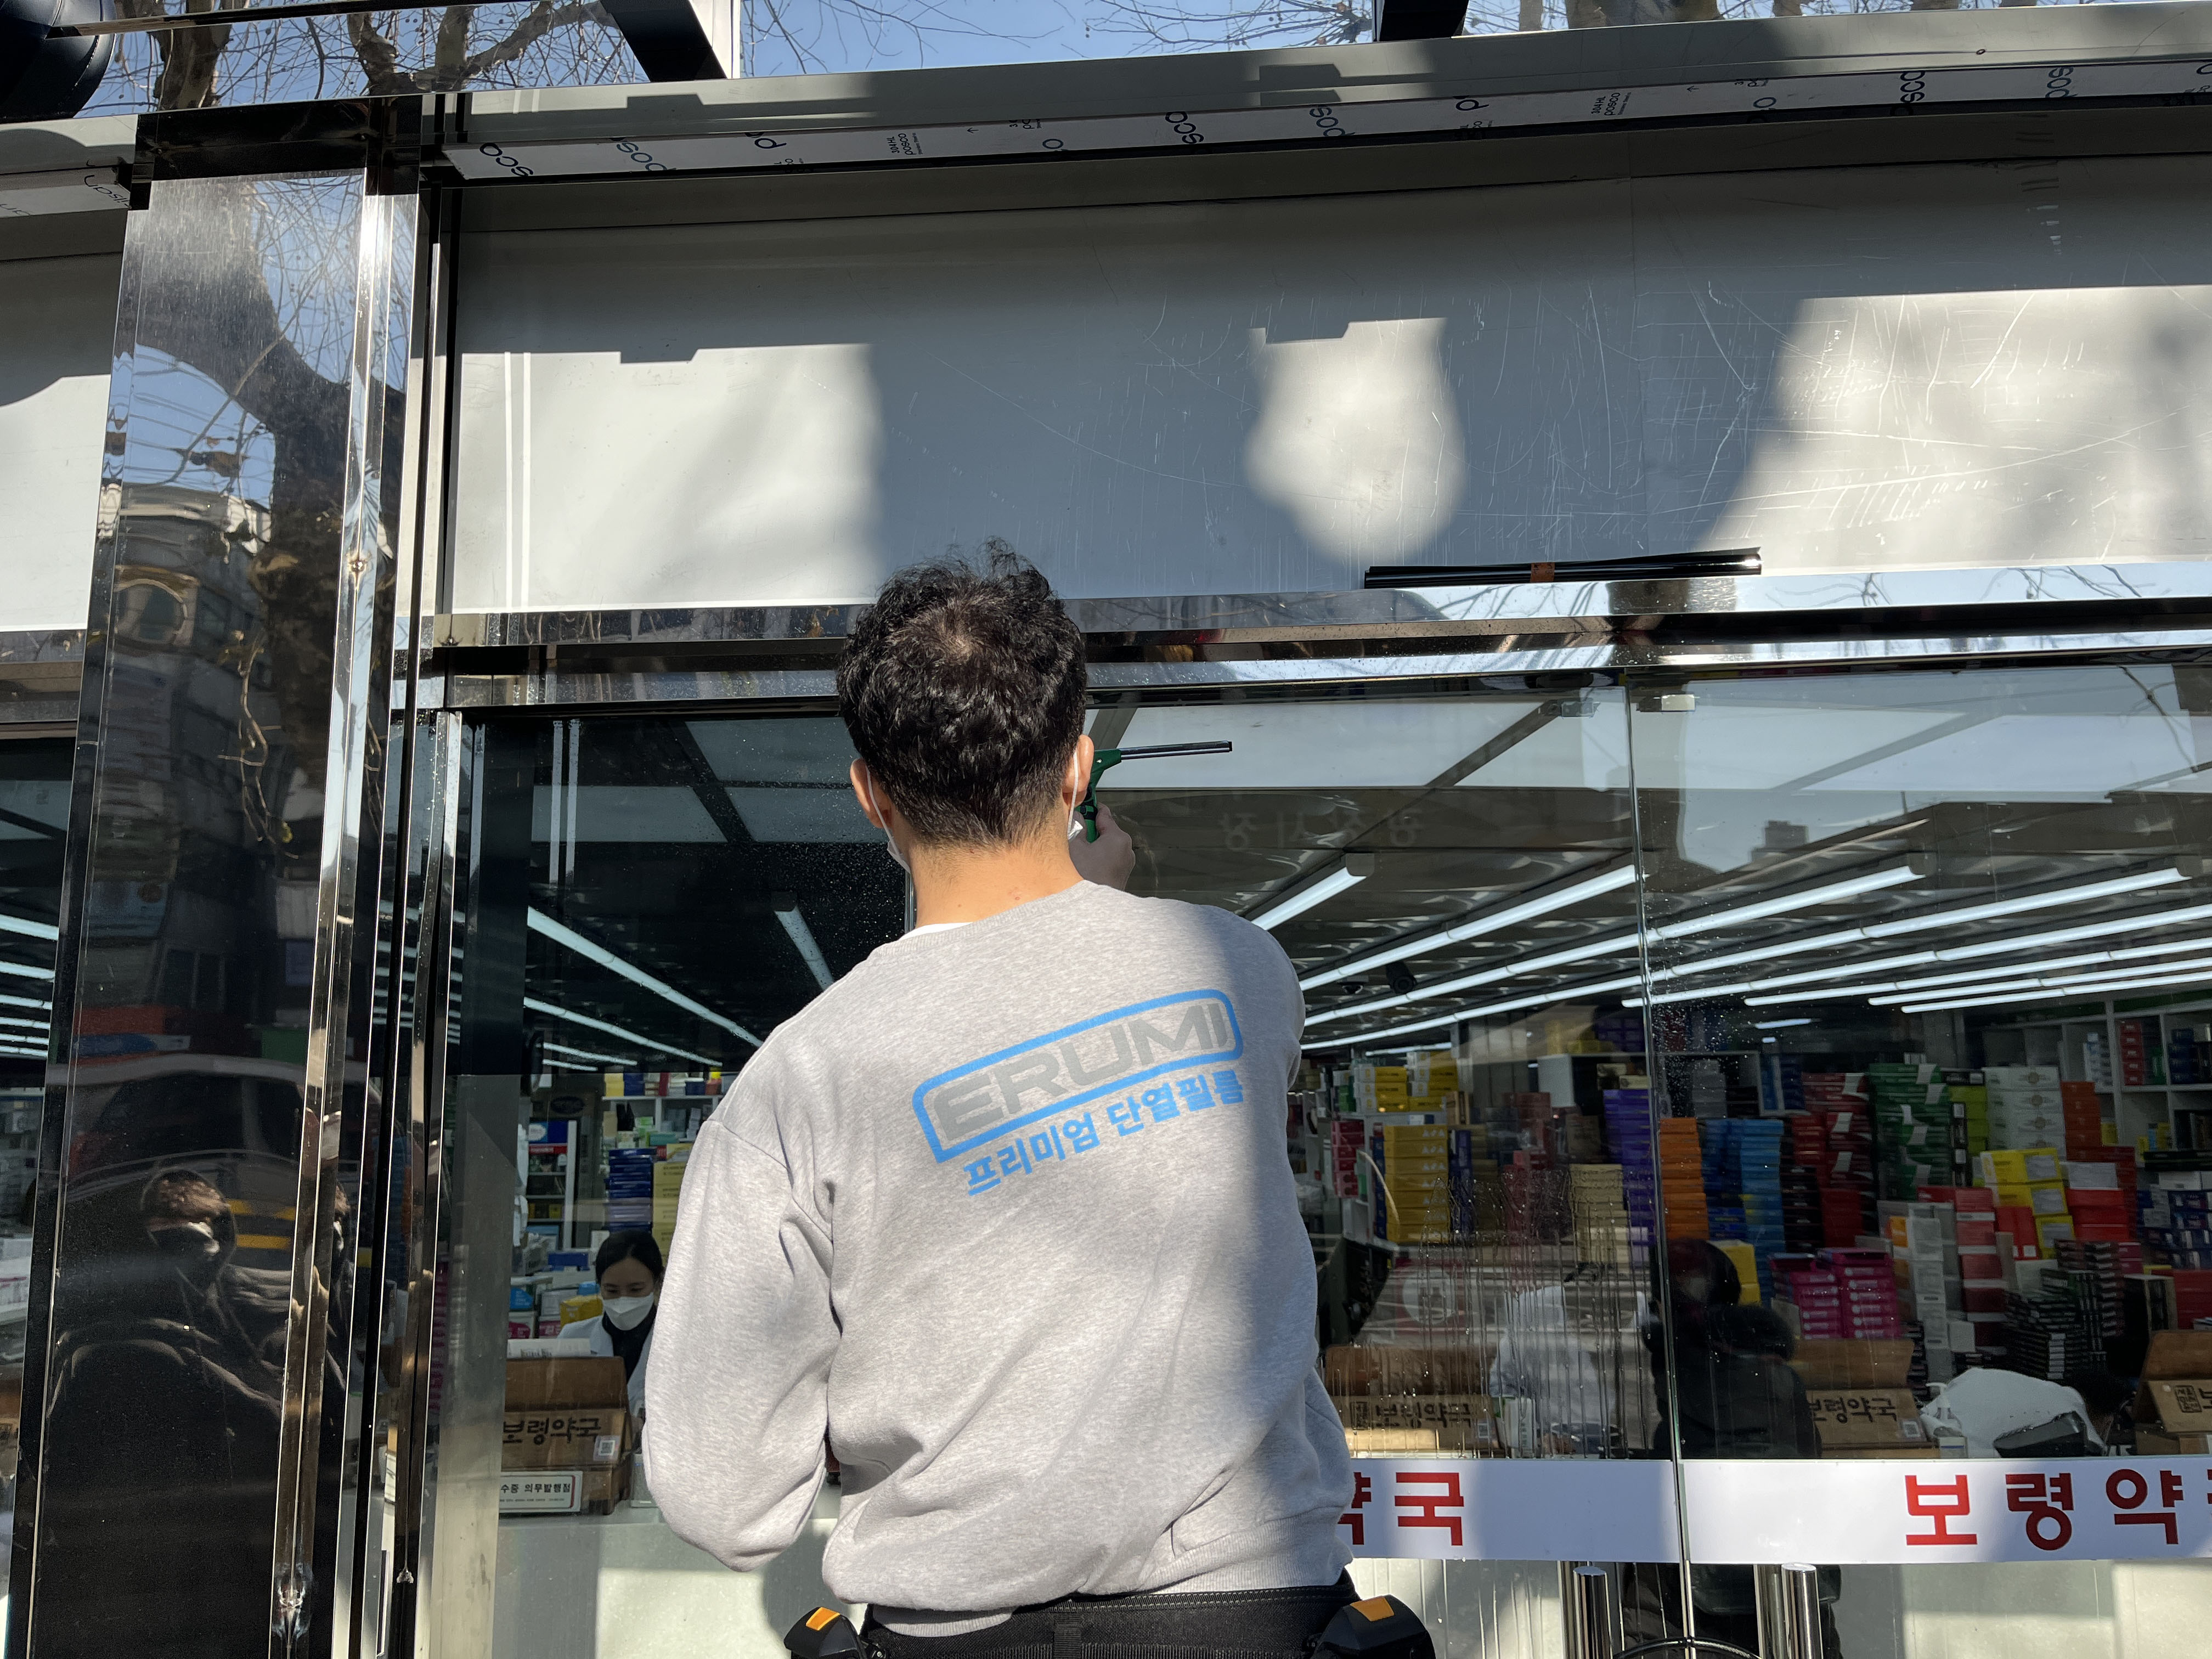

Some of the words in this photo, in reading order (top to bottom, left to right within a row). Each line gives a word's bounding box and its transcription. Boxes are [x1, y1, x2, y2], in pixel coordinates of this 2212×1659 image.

[1604, 92, 1621, 116] posco
[886, 136, 900, 154] 304HL
[898, 133, 917, 155] posco
[934, 1003, 1228, 1141] ERUMI
[964, 1111, 1100, 1197] 프리미엄
[1107, 1069, 1244, 1137] 단열필름
[502, 1418, 601, 1446] 보령약국
[1905, 1468, 2212, 1551] 보령약
